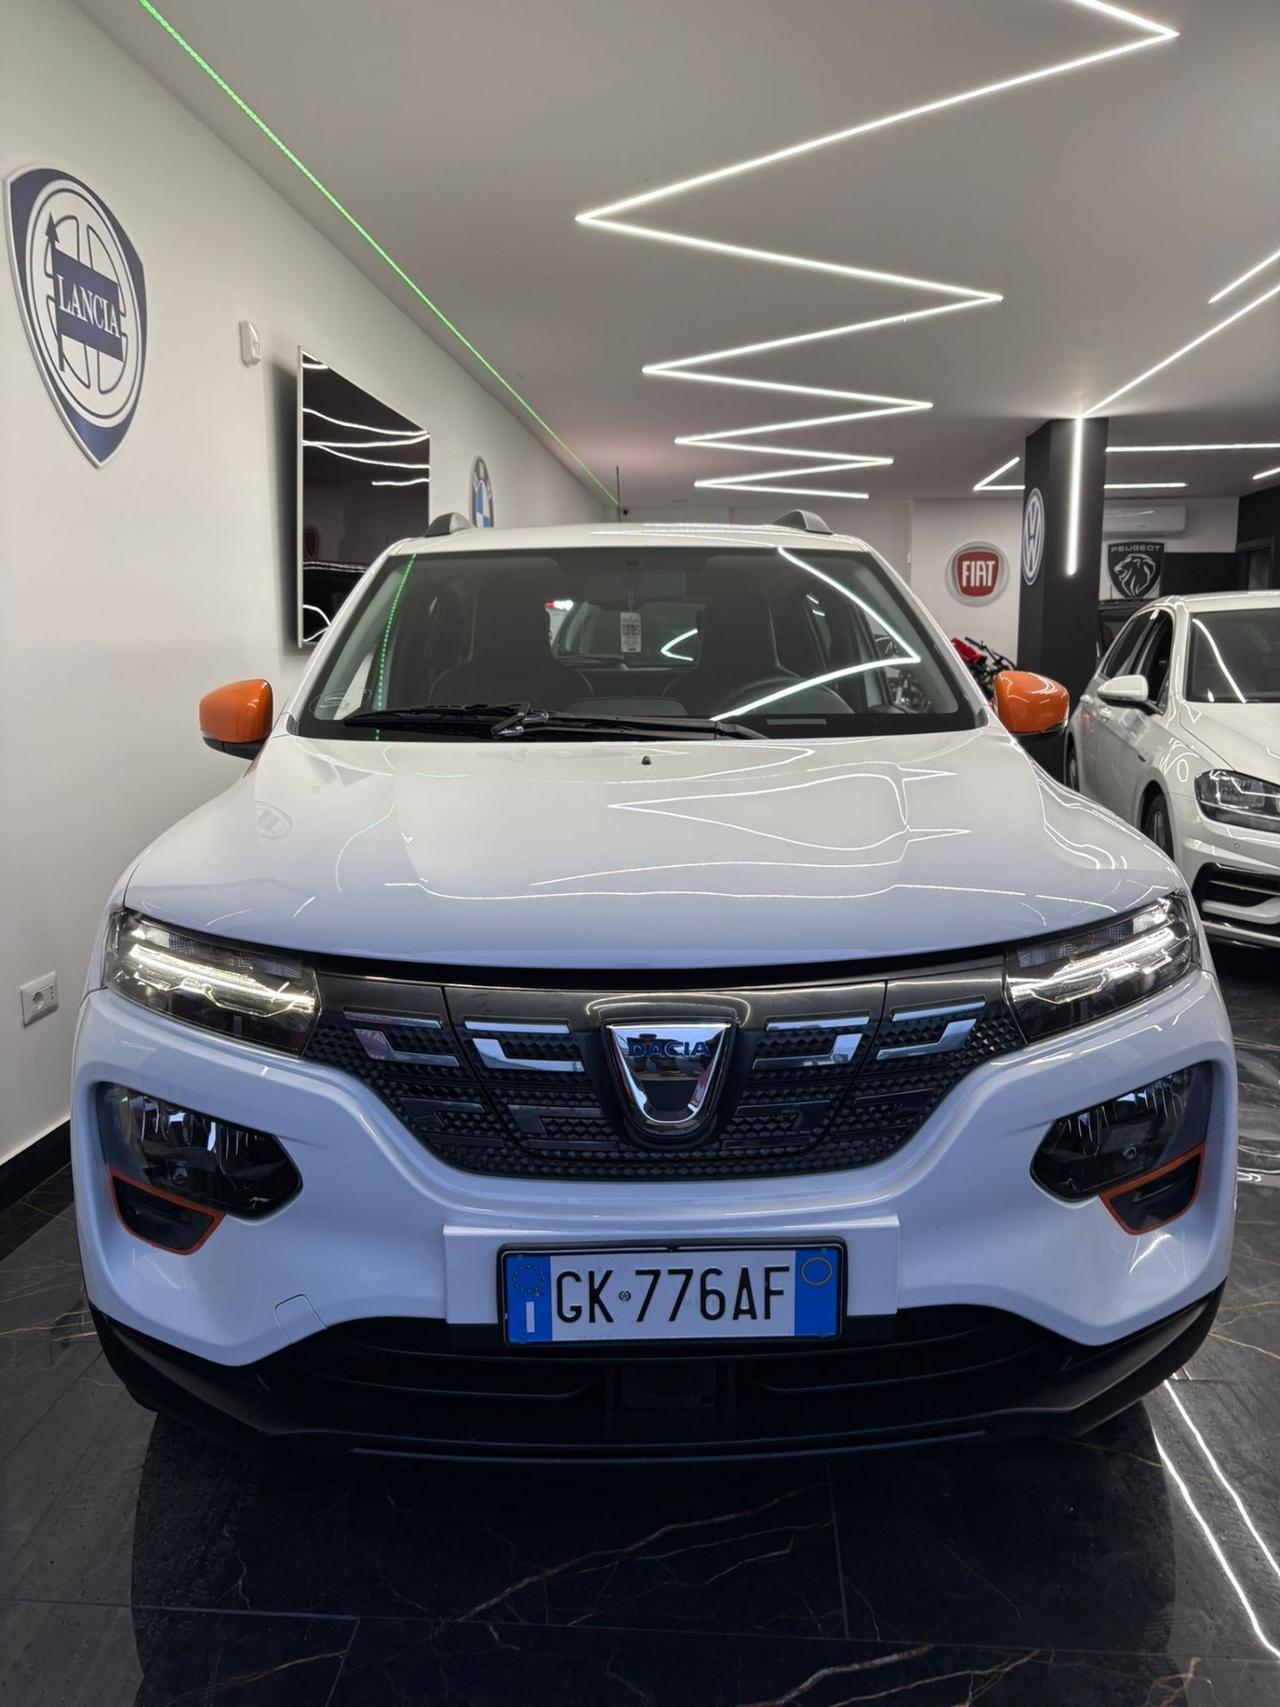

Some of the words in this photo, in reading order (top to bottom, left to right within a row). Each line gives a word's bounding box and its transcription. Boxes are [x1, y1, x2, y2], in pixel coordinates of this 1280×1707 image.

[57, 274, 121, 338] LANCIA
[1110, 544, 1161, 553] PEUGEOT
[961, 560, 996, 587] FIAT
[628, 1041, 710, 1057] DACIA
